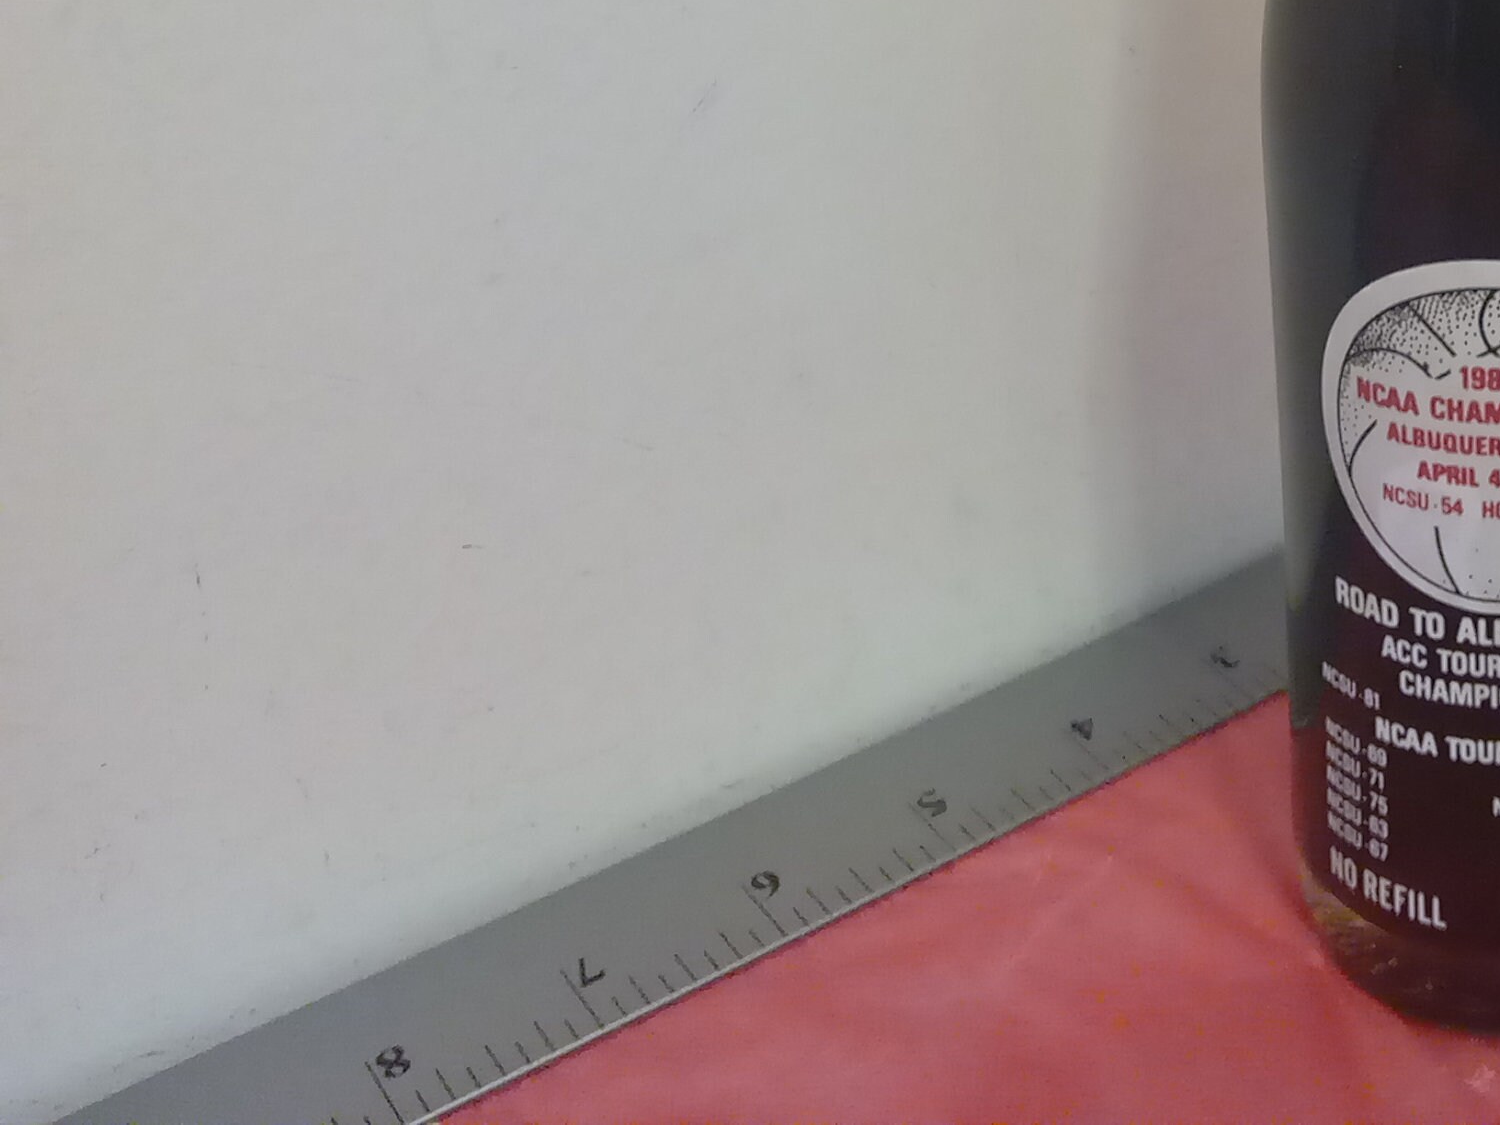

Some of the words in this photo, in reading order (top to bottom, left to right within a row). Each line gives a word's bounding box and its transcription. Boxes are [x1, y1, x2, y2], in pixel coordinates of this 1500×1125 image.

[1357, 376, 1420, 416] NCAA
[1417, 460, 1479, 487] APRIL
[1335, 575, 1400, 627] ROAD
[1408, 606, 1445, 640] TO
[1381, 634, 1428, 669] ACC
[1375, 716, 1438, 757] NCAA
[917, 787, 947, 817] 5
[1330, 846, 1357, 890] NO
[1363, 869, 1447, 930] REFILL
[578, 957, 606, 988] 7
[376, 1044, 411, 1078] 8
